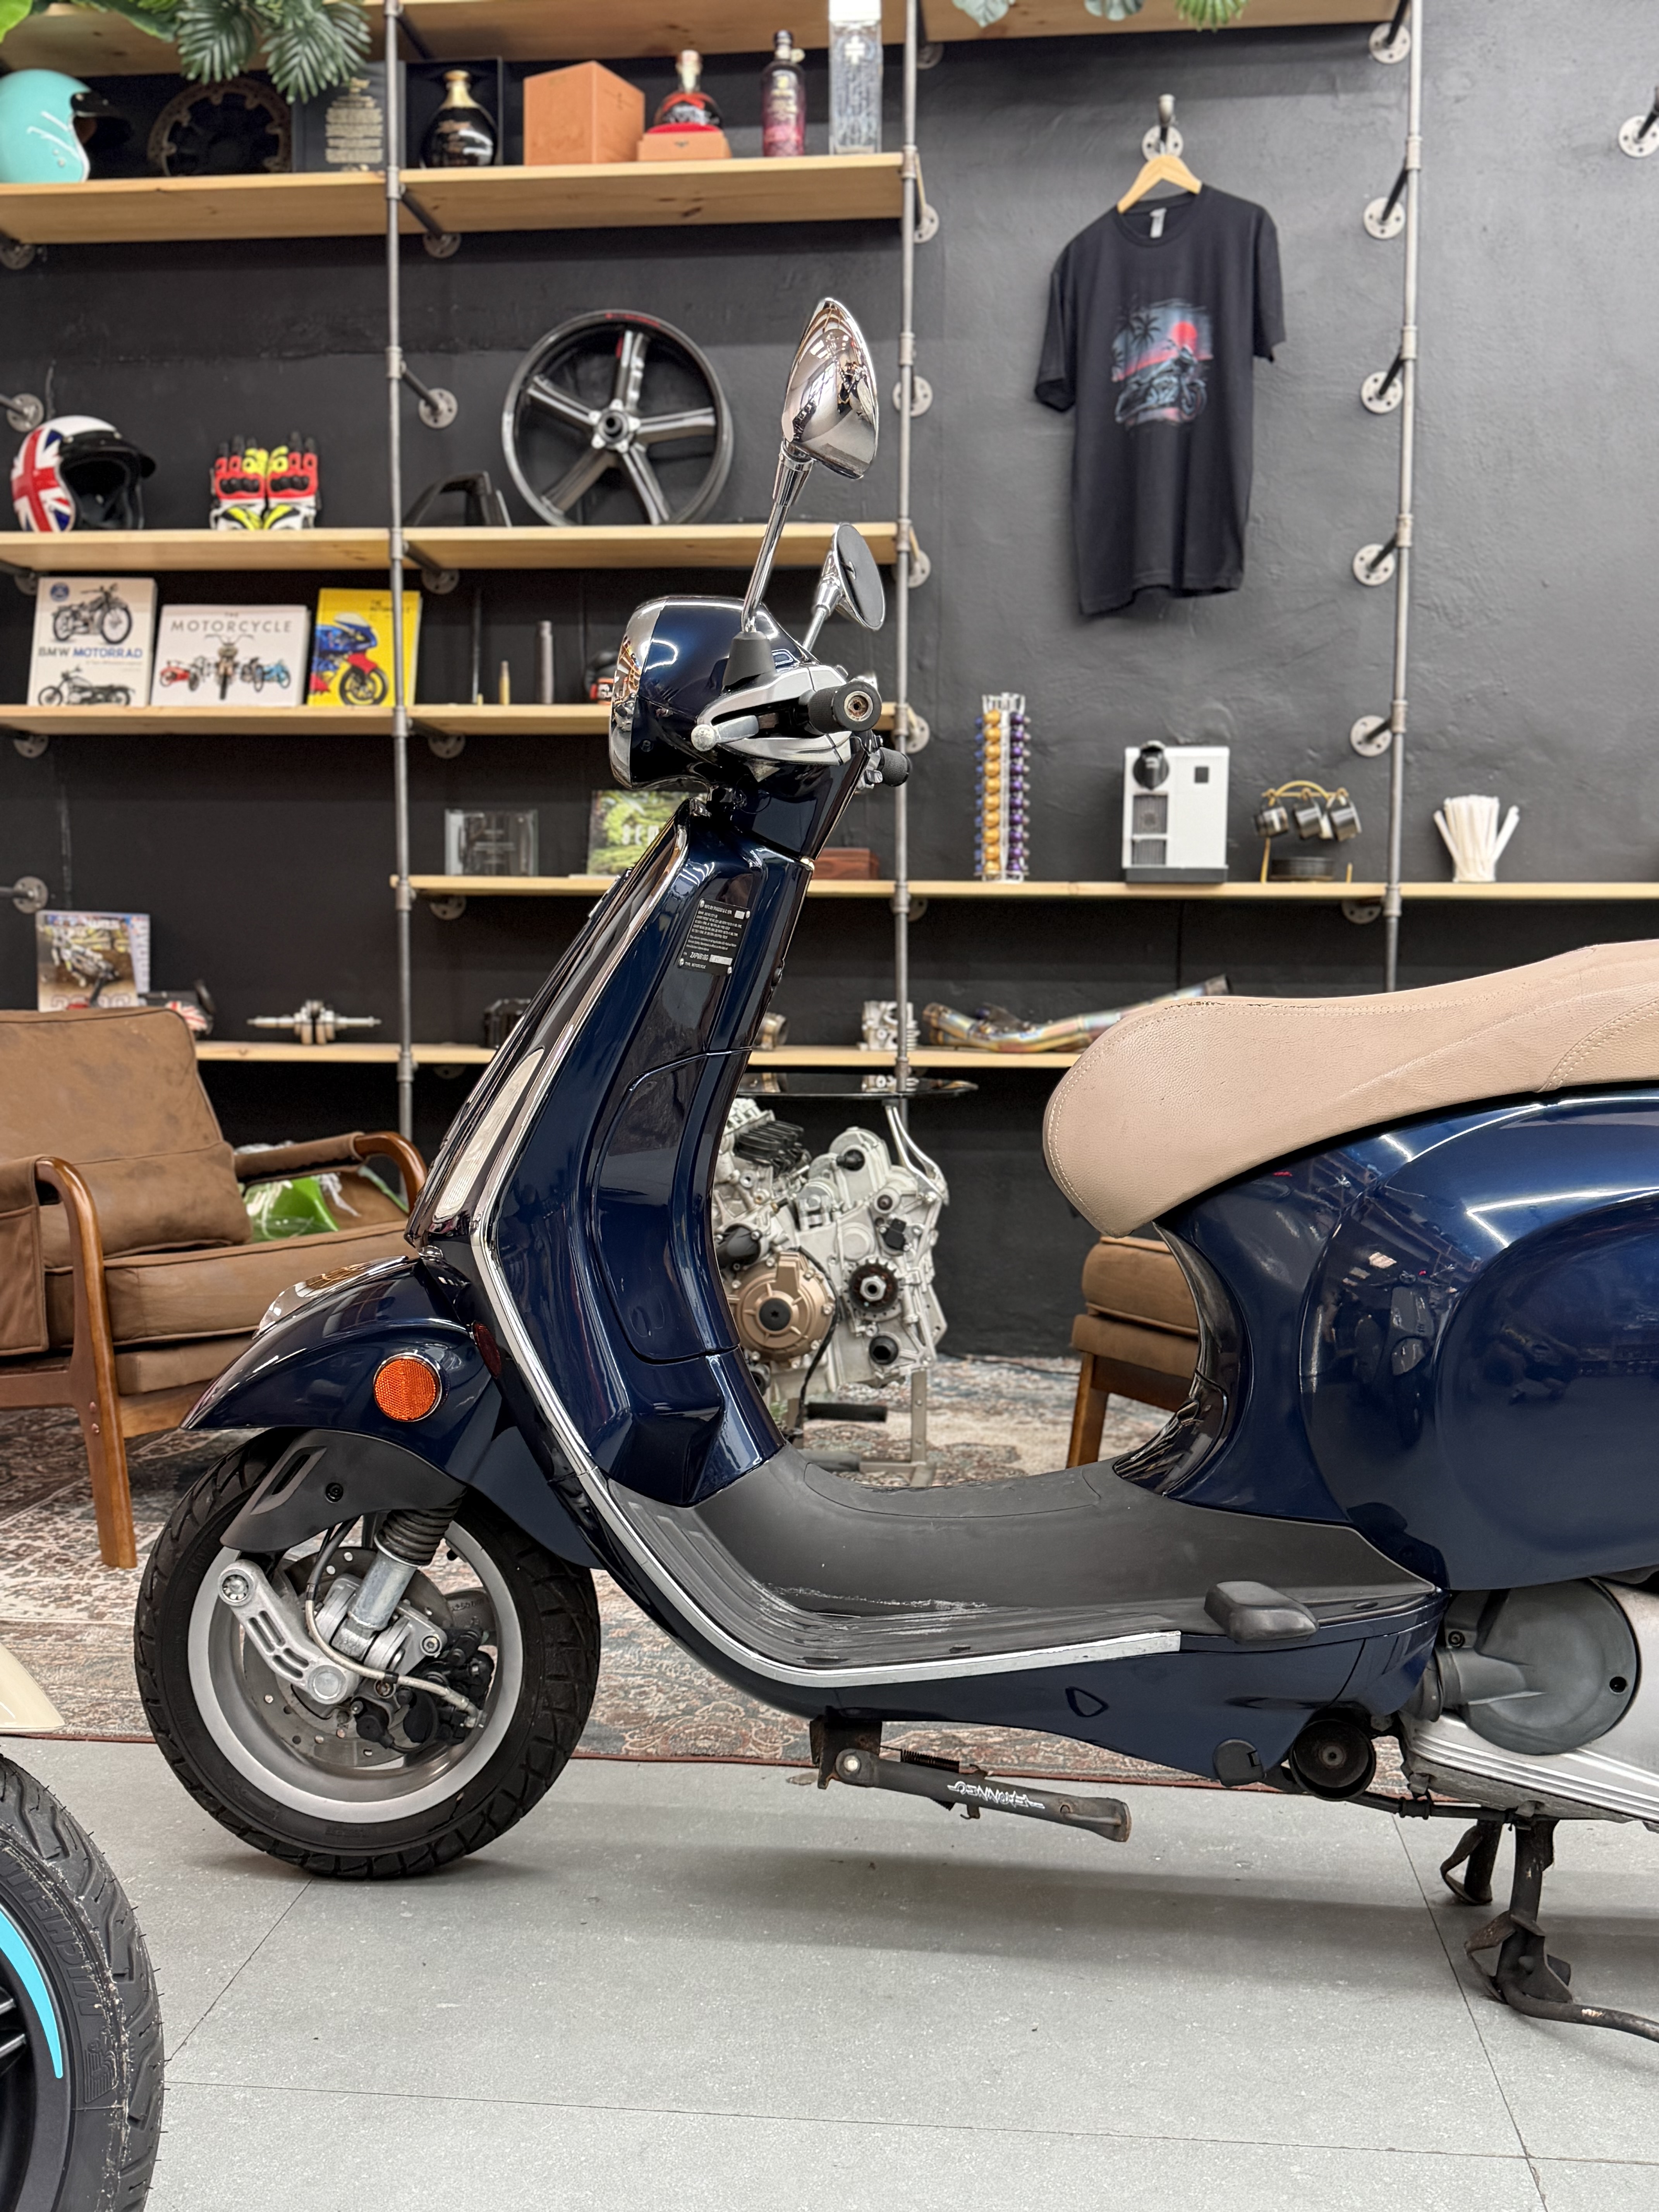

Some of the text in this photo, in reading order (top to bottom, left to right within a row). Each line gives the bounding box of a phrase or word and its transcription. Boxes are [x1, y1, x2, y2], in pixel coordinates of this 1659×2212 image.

[170, 620, 292, 633] MOTORCYCLE
[38, 647, 143, 658] BMW MOTORRAD
